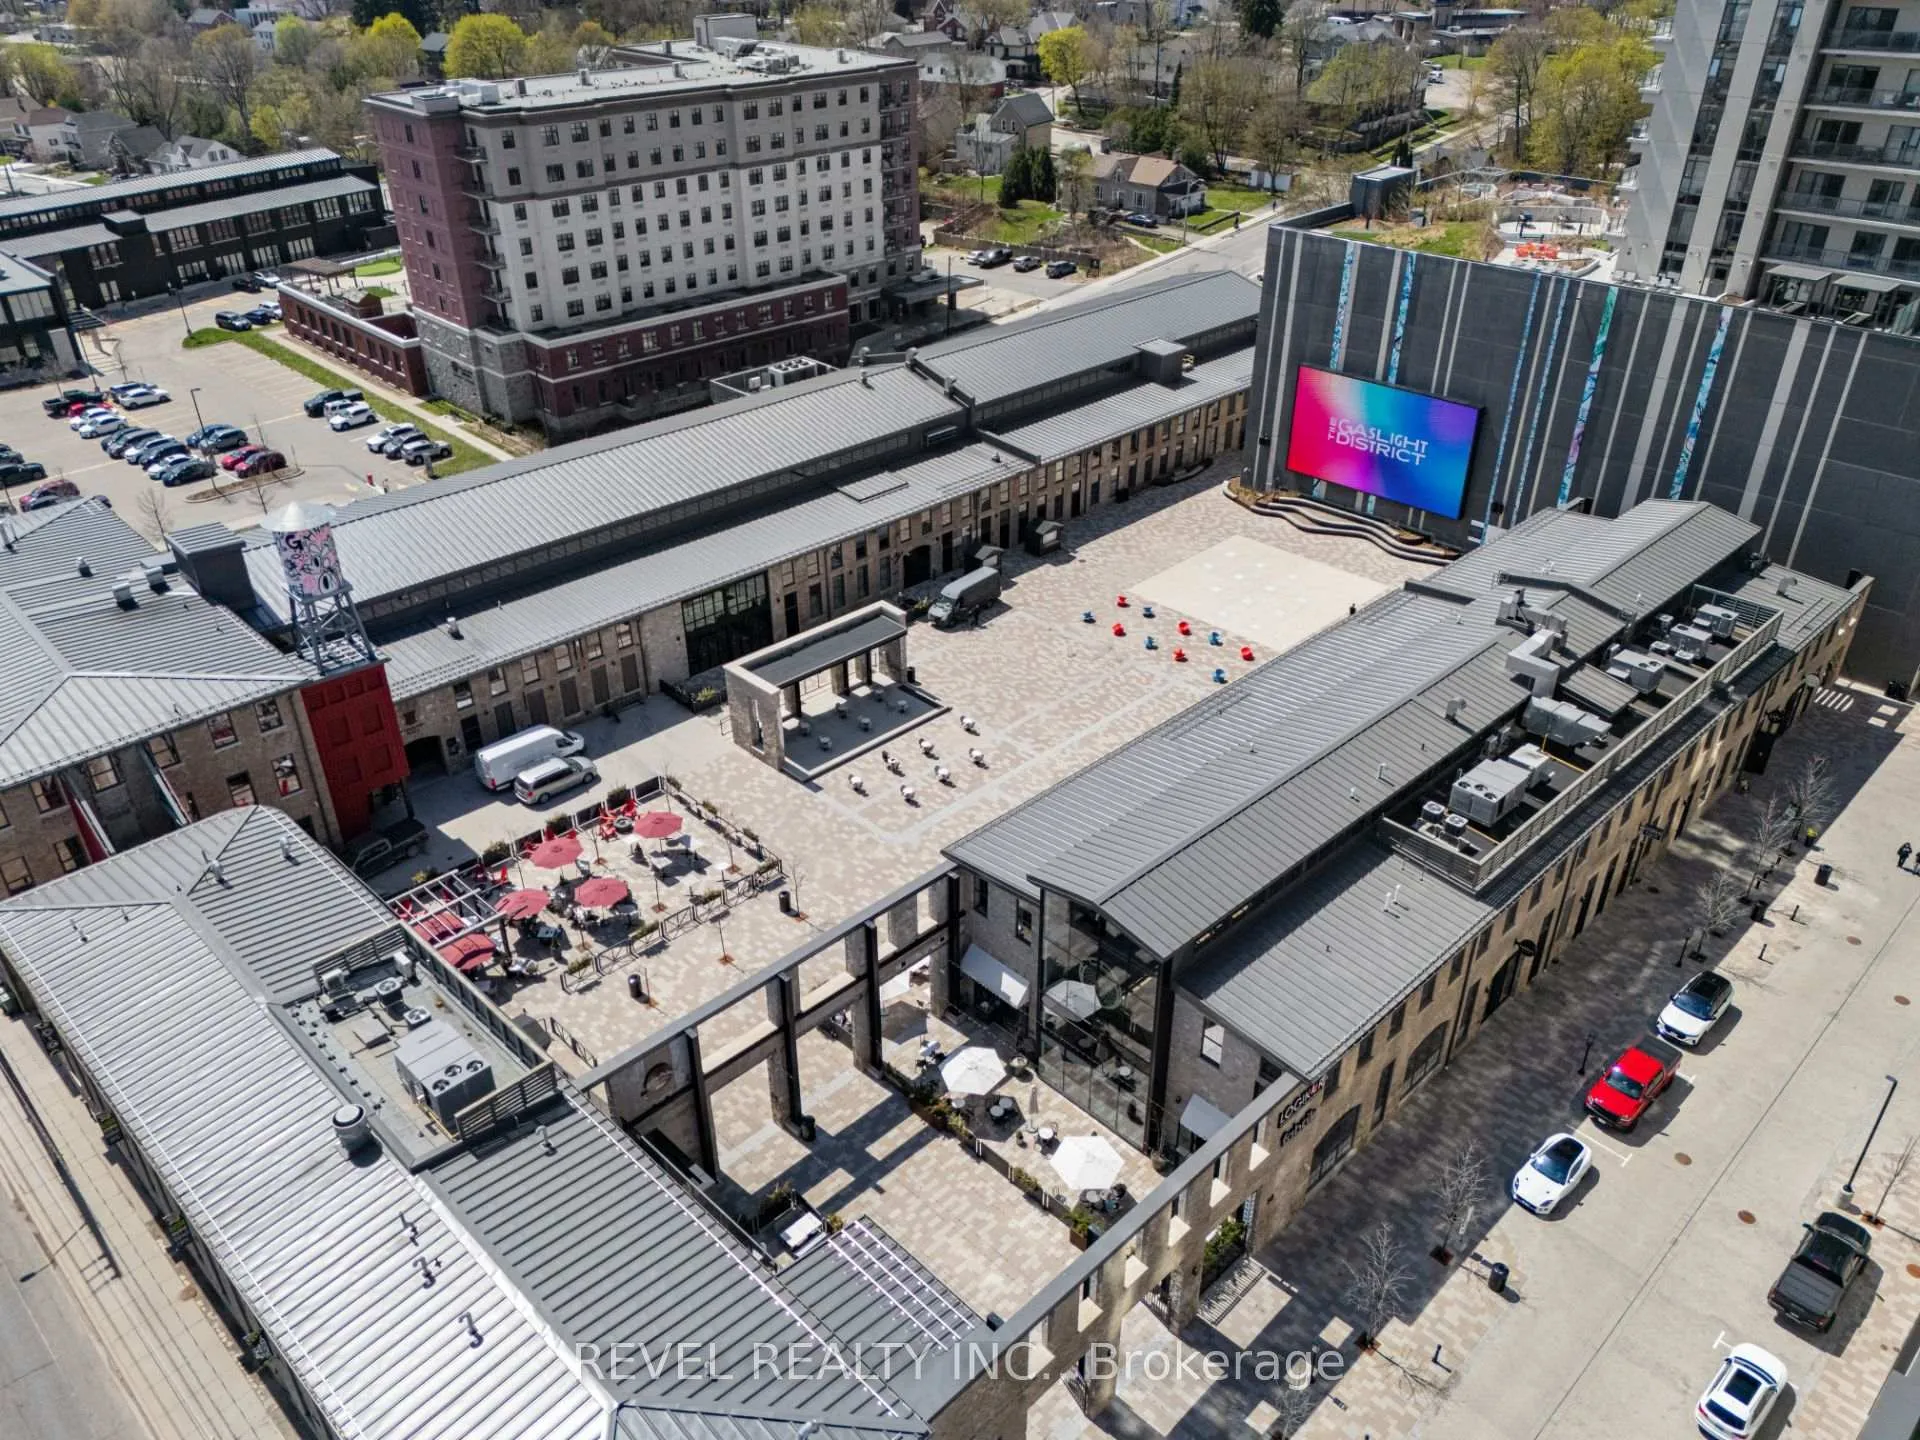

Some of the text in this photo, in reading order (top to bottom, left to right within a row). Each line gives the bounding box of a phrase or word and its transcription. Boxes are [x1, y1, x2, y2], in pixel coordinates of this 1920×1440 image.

[1327, 416, 1337, 440] THE
[1337, 418, 1428, 454] GASLIGHT
[1336, 432, 1426, 465] DISTRICT
